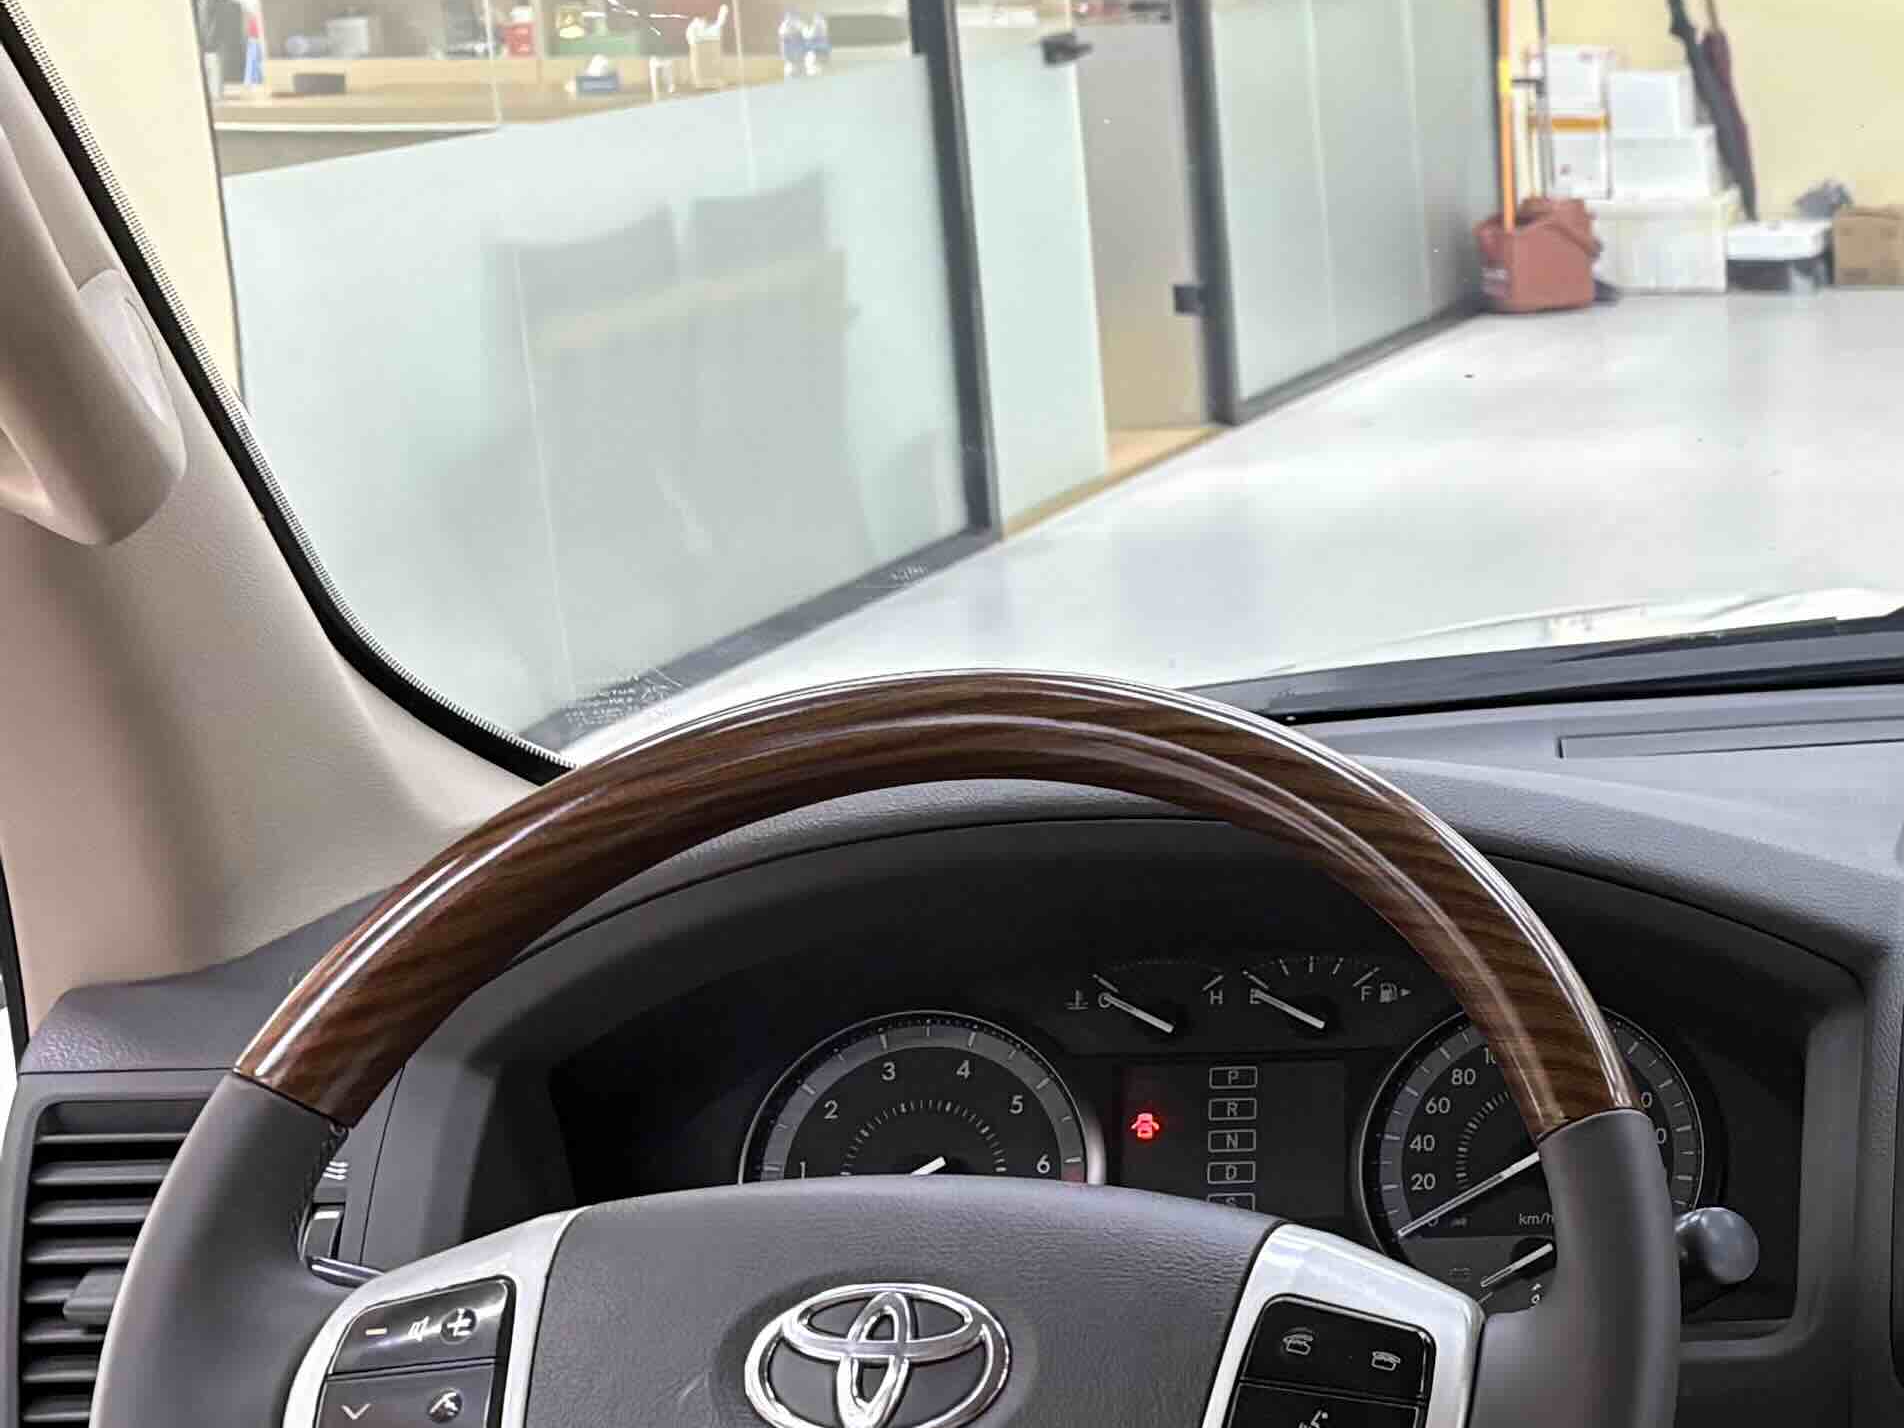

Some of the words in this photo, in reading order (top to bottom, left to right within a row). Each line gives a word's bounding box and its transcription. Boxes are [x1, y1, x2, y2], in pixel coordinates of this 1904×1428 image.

[1210, 990, 1223, 1005] H
[1361, 986, 1373, 1001] F
[881, 1062, 896, 1081] 3
[956, 1060, 971, 1078] 4
[1228, 1070, 1239, 1084] P
[1451, 1068, 1476, 1085] 80
[824, 1100, 839, 1119] 2
[1009, 1095, 1024, 1114] 5
[1226, 1102, 1239, 1117] R
[1425, 1097, 1451, 1114] 60
[1226, 1133, 1239, 1148] N
[1410, 1134, 1436, 1151] 40
[1036, 1154, 1050, 1173] 6
[1411, 1173, 1437, 1190] 20
[1519, 1212, 1554, 1225] km/h
